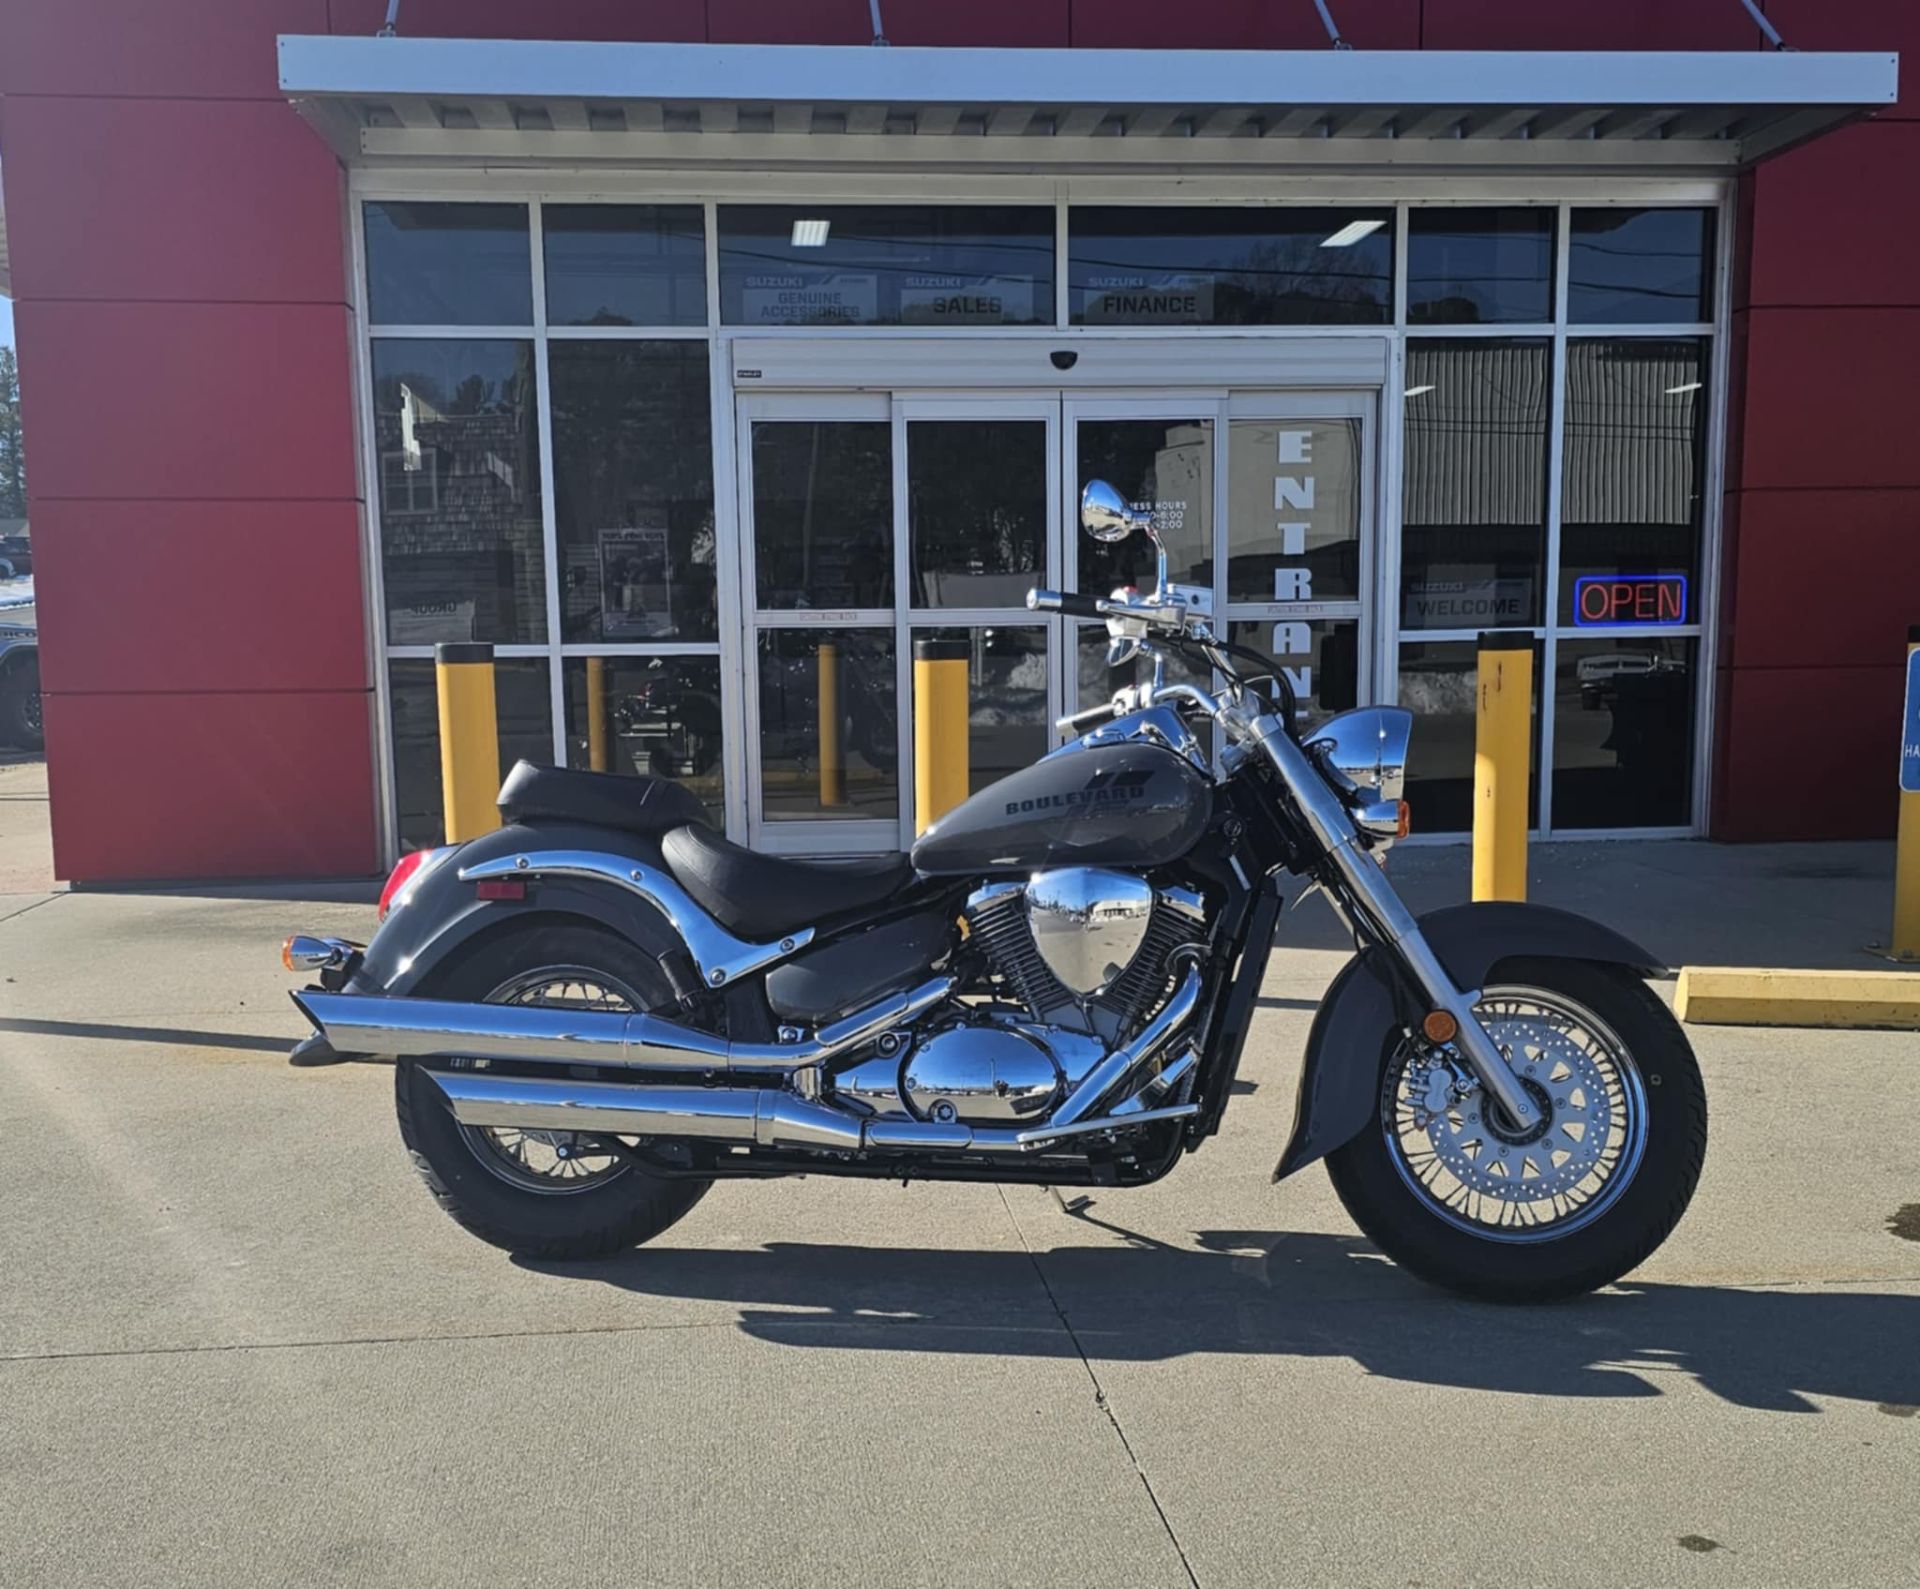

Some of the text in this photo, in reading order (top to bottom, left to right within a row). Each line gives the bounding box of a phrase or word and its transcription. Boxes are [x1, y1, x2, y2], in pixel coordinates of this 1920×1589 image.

[745, 276, 803, 287] SUZUKI
[1088, 277, 1144, 287] SUZUKI
[778, 292, 842, 304] GENUINE
[933, 296, 1002, 314] SALES
[1103, 296, 1196, 313] FINANCE
[761, 306, 860, 318] ACCESSORIES
[1155, 501, 1187, 510] HOURS
[1417, 599, 1520, 616] WELCOME
[1580, 583, 1681, 619] OPEN
[1006, 786, 1145, 815] BOULEVARD
